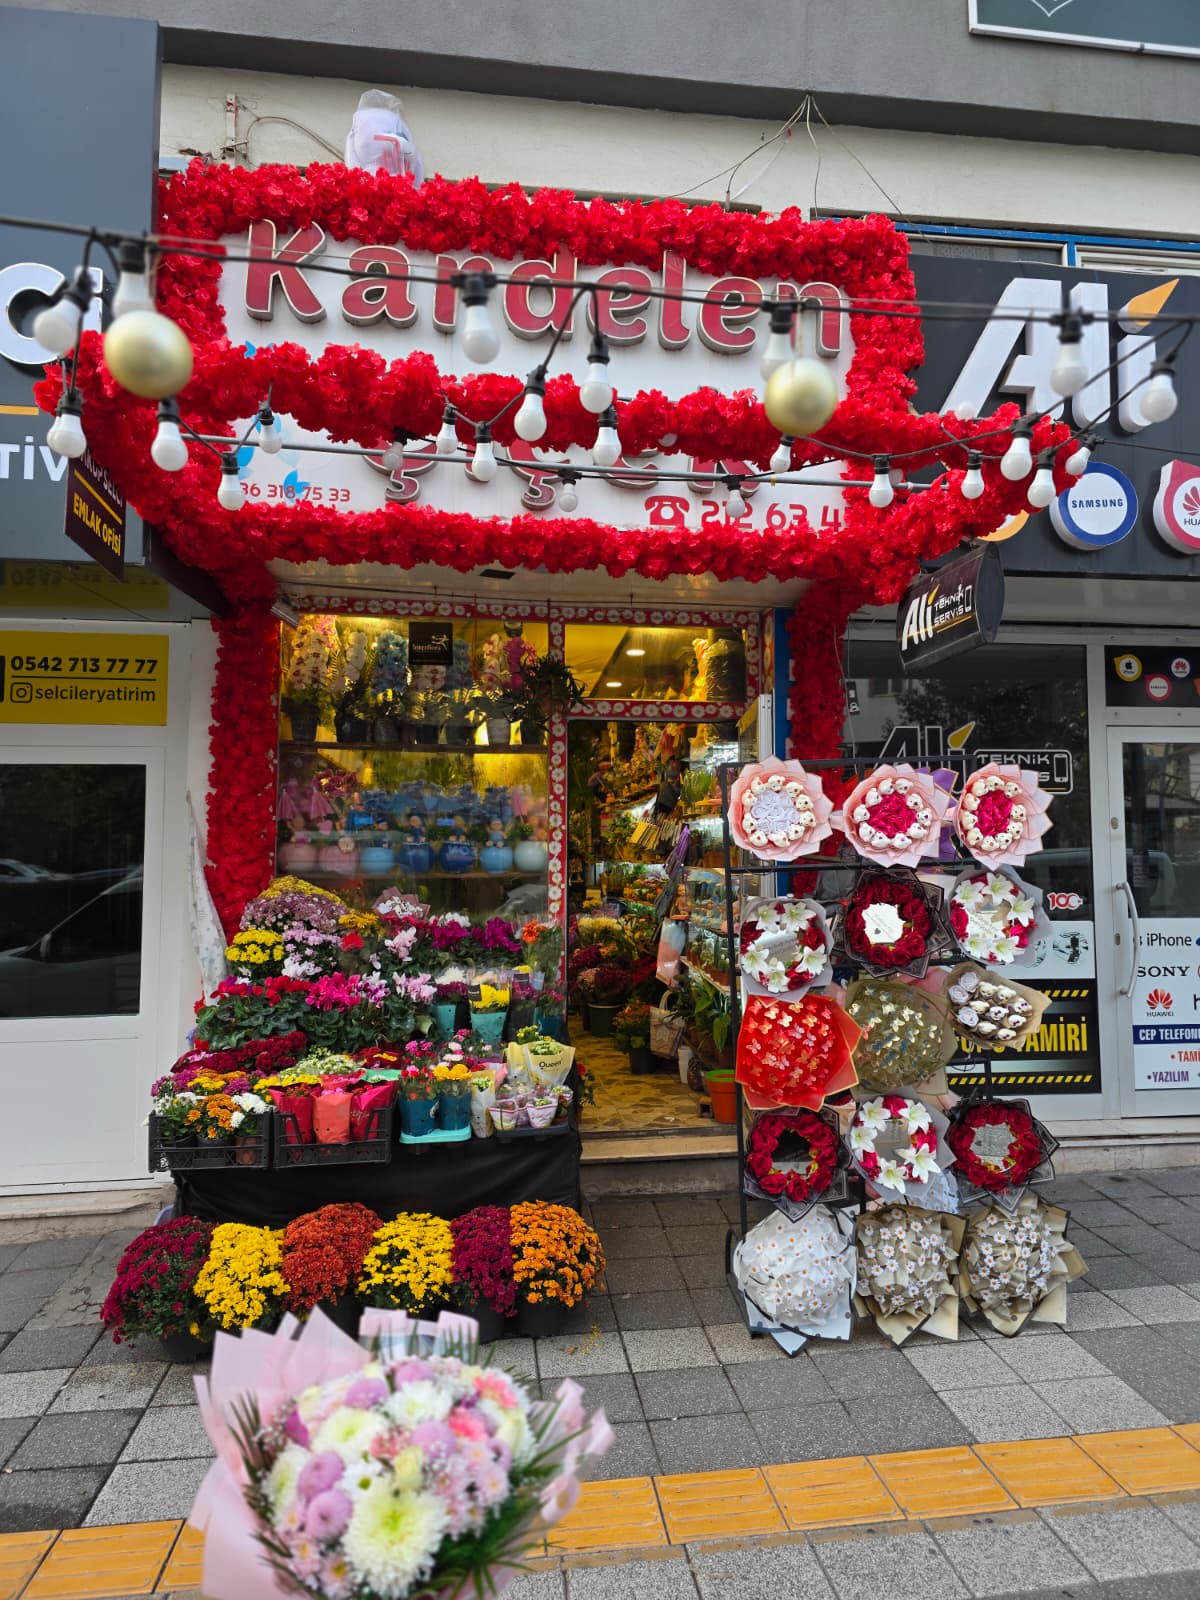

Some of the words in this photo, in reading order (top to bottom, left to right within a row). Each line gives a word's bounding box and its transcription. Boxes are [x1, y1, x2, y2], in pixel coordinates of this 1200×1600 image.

[246, 219, 841, 358] Kardelen
[267, 484, 296, 499] 318
[302, 486, 323, 501] 75
[329, 488, 351, 502] 33
[1072, 498, 1124, 509] SAMSUNG
[73, 492, 102, 537] EMLAK
[102, 523, 122, 556] OFİSİ
[821, 505, 849, 532] 4
[901, 584, 940, 651] Ali
[11, 656, 62, 671] 0542
[68, 657, 100, 672] 713
[106, 658, 129, 673] 77
[135, 659, 158, 674] 77
[35, 684, 156, 703] selcileryatirim
[1146, 932, 1192, 946] iPhone
[1137, 966, 1190, 977] SONY
[1017, 1016, 1088, 1053] AMİRİ
[1139, 1029, 1157, 1040] CEP
[1158, 1028, 1200, 1040] TELEFON
[1152, 1070, 1190, 1083] YAZILIM
